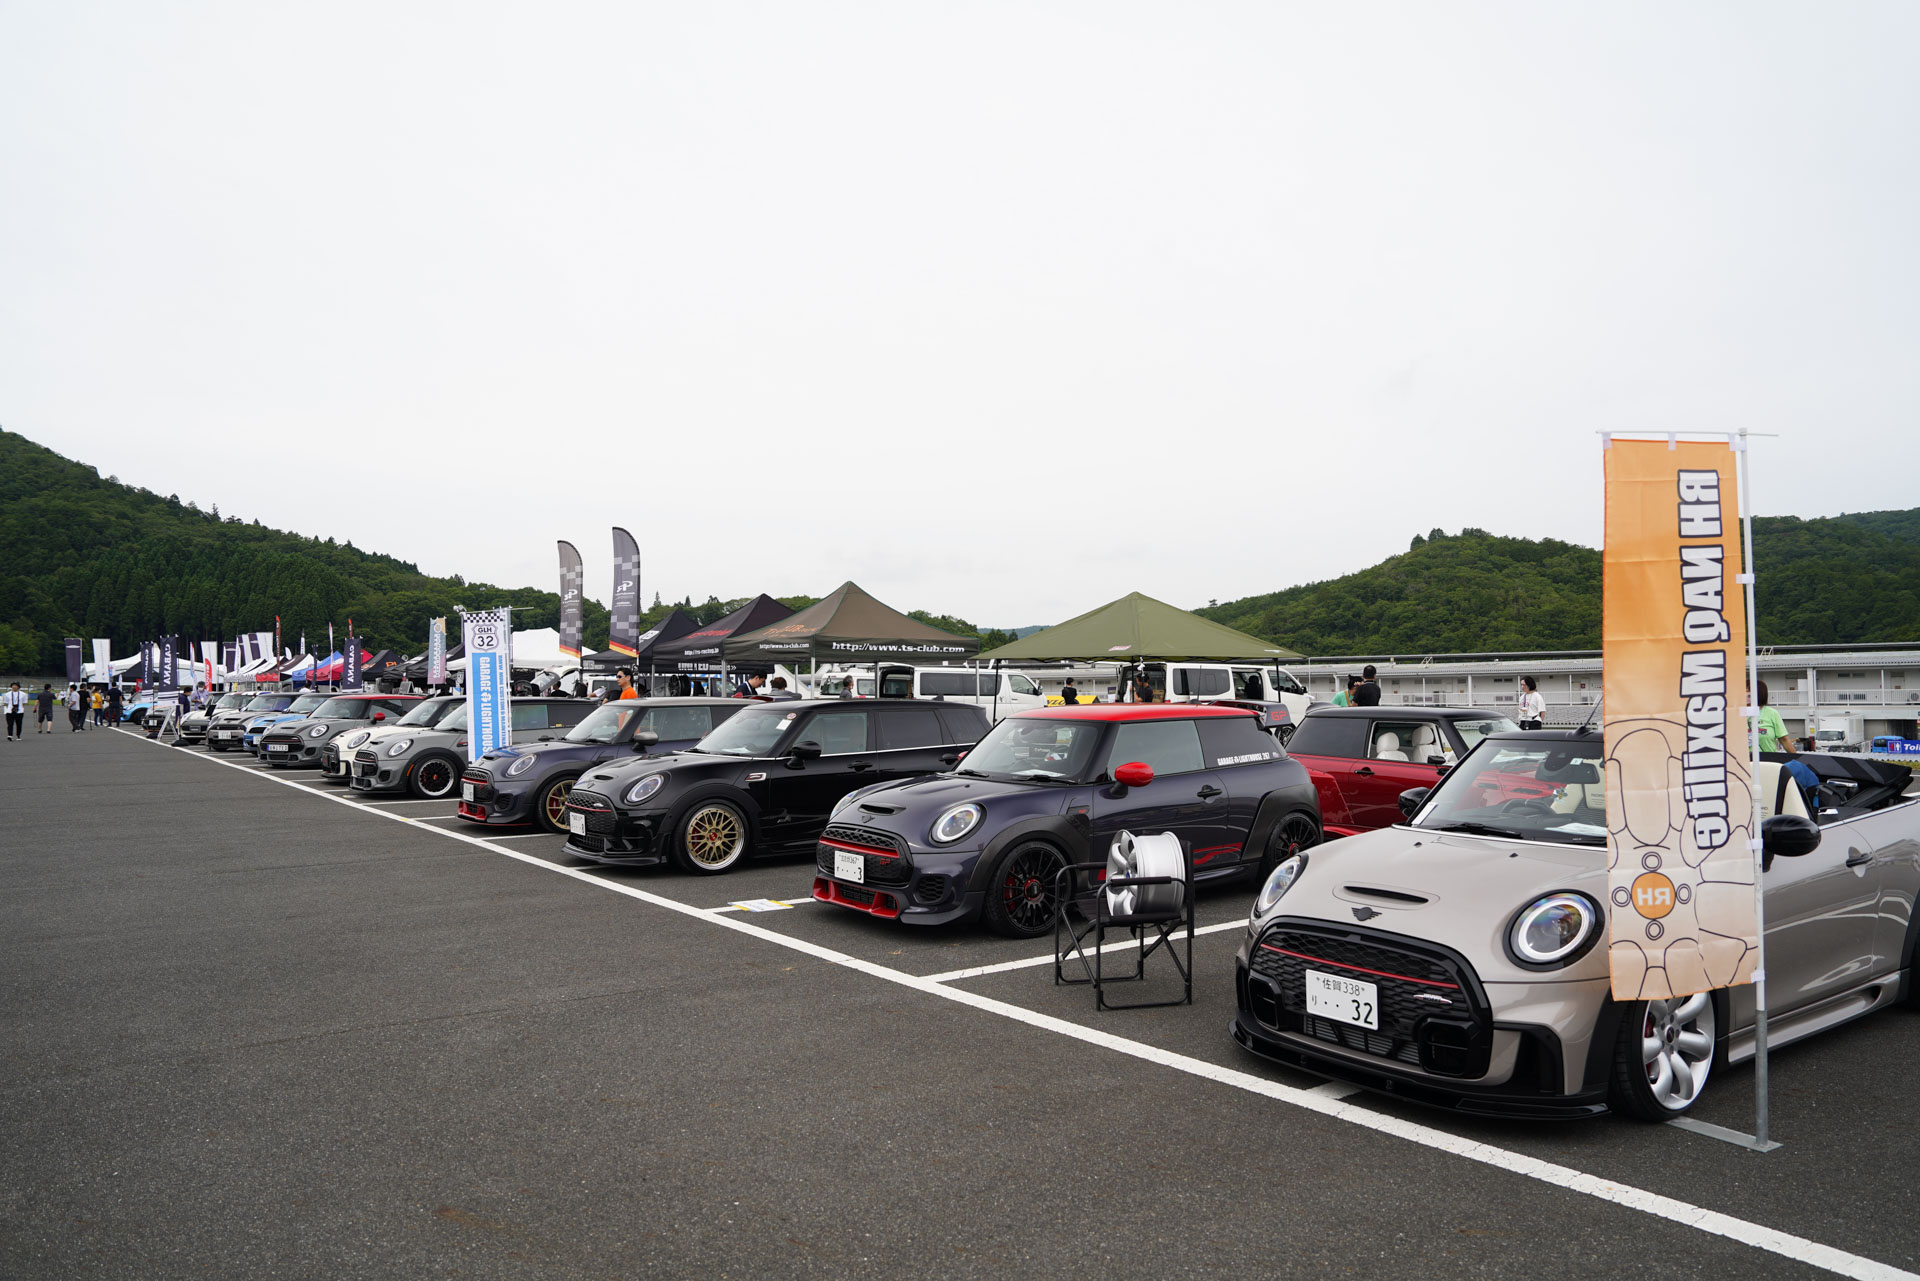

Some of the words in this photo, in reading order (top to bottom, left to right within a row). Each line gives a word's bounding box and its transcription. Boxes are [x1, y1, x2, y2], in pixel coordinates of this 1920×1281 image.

[477, 634, 496, 648] 32
[831, 641, 966, 654] http://www.ts-club.com
[479, 656, 492, 692] GARAGE
[1271, 710, 1287, 721] GP
[481, 702, 494, 755] LIGHTHOUS
[1351, 999, 1374, 1026] 32
